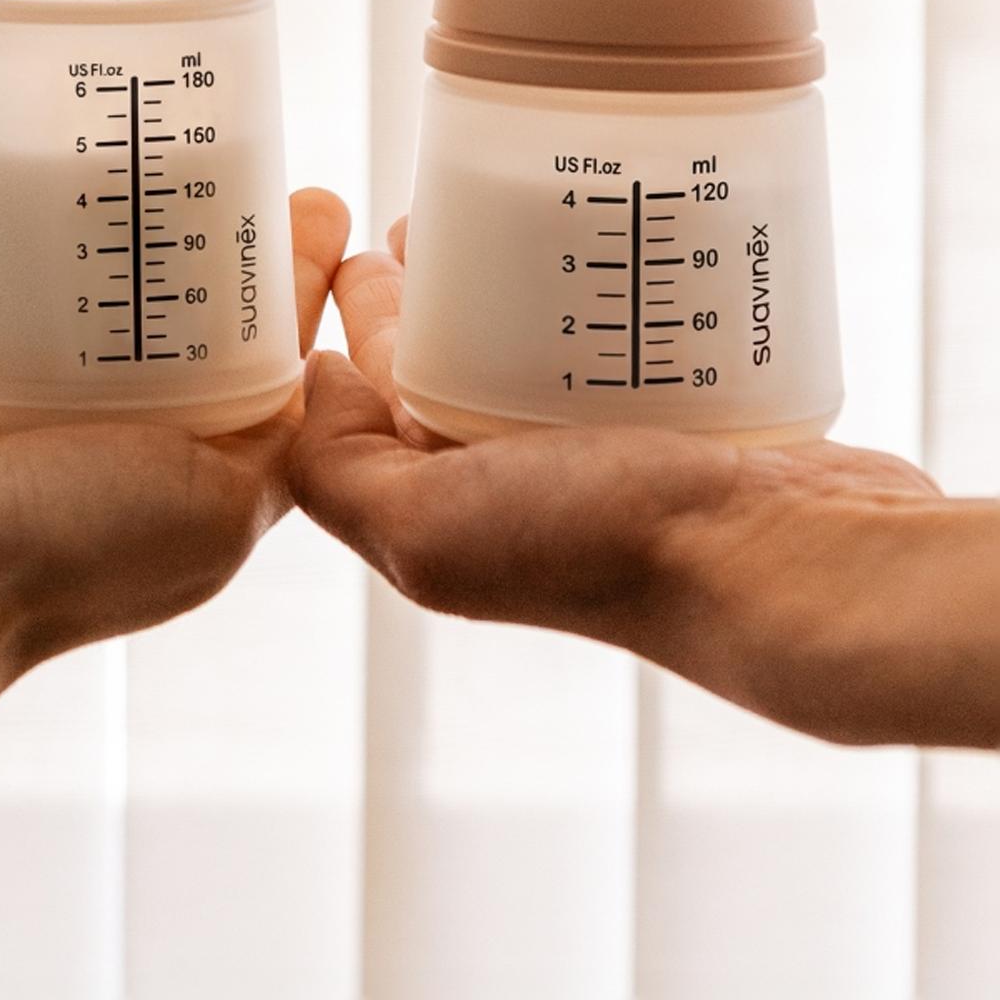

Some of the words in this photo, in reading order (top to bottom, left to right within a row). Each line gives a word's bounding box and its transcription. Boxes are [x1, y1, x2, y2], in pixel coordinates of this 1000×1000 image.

[180, 51, 202, 68] ml
[68, 64, 89, 77] US
[90, 63, 124, 77] Fl.oz
[182, 70, 215, 89] 180
[75, 81, 87, 98] 6
[75, 136, 88, 154] 5
[183, 126, 216, 145] 160
[554, 155, 579, 173] US
[582, 157, 622, 176] Fl.oz
[691, 154, 717, 175] ml
[183, 180, 216, 199] 120
[561, 189, 577, 209] 4
[690, 181, 729, 203] 120
[76, 192, 88, 209] 4
[76, 243, 89, 260] 3
[183, 233, 207, 252] 90
[561, 254, 576, 274] 3
[692, 248, 719, 270] 90
[77, 296, 89, 313] 2
[184, 287, 208, 305] 60
[561, 314, 576, 335] 2
[691, 310, 718, 332] 60
[78, 350, 87, 367] 1
[186, 343, 208, 362] 30
[561, 371, 573, 391] 1
[691, 366, 718, 388] 30
